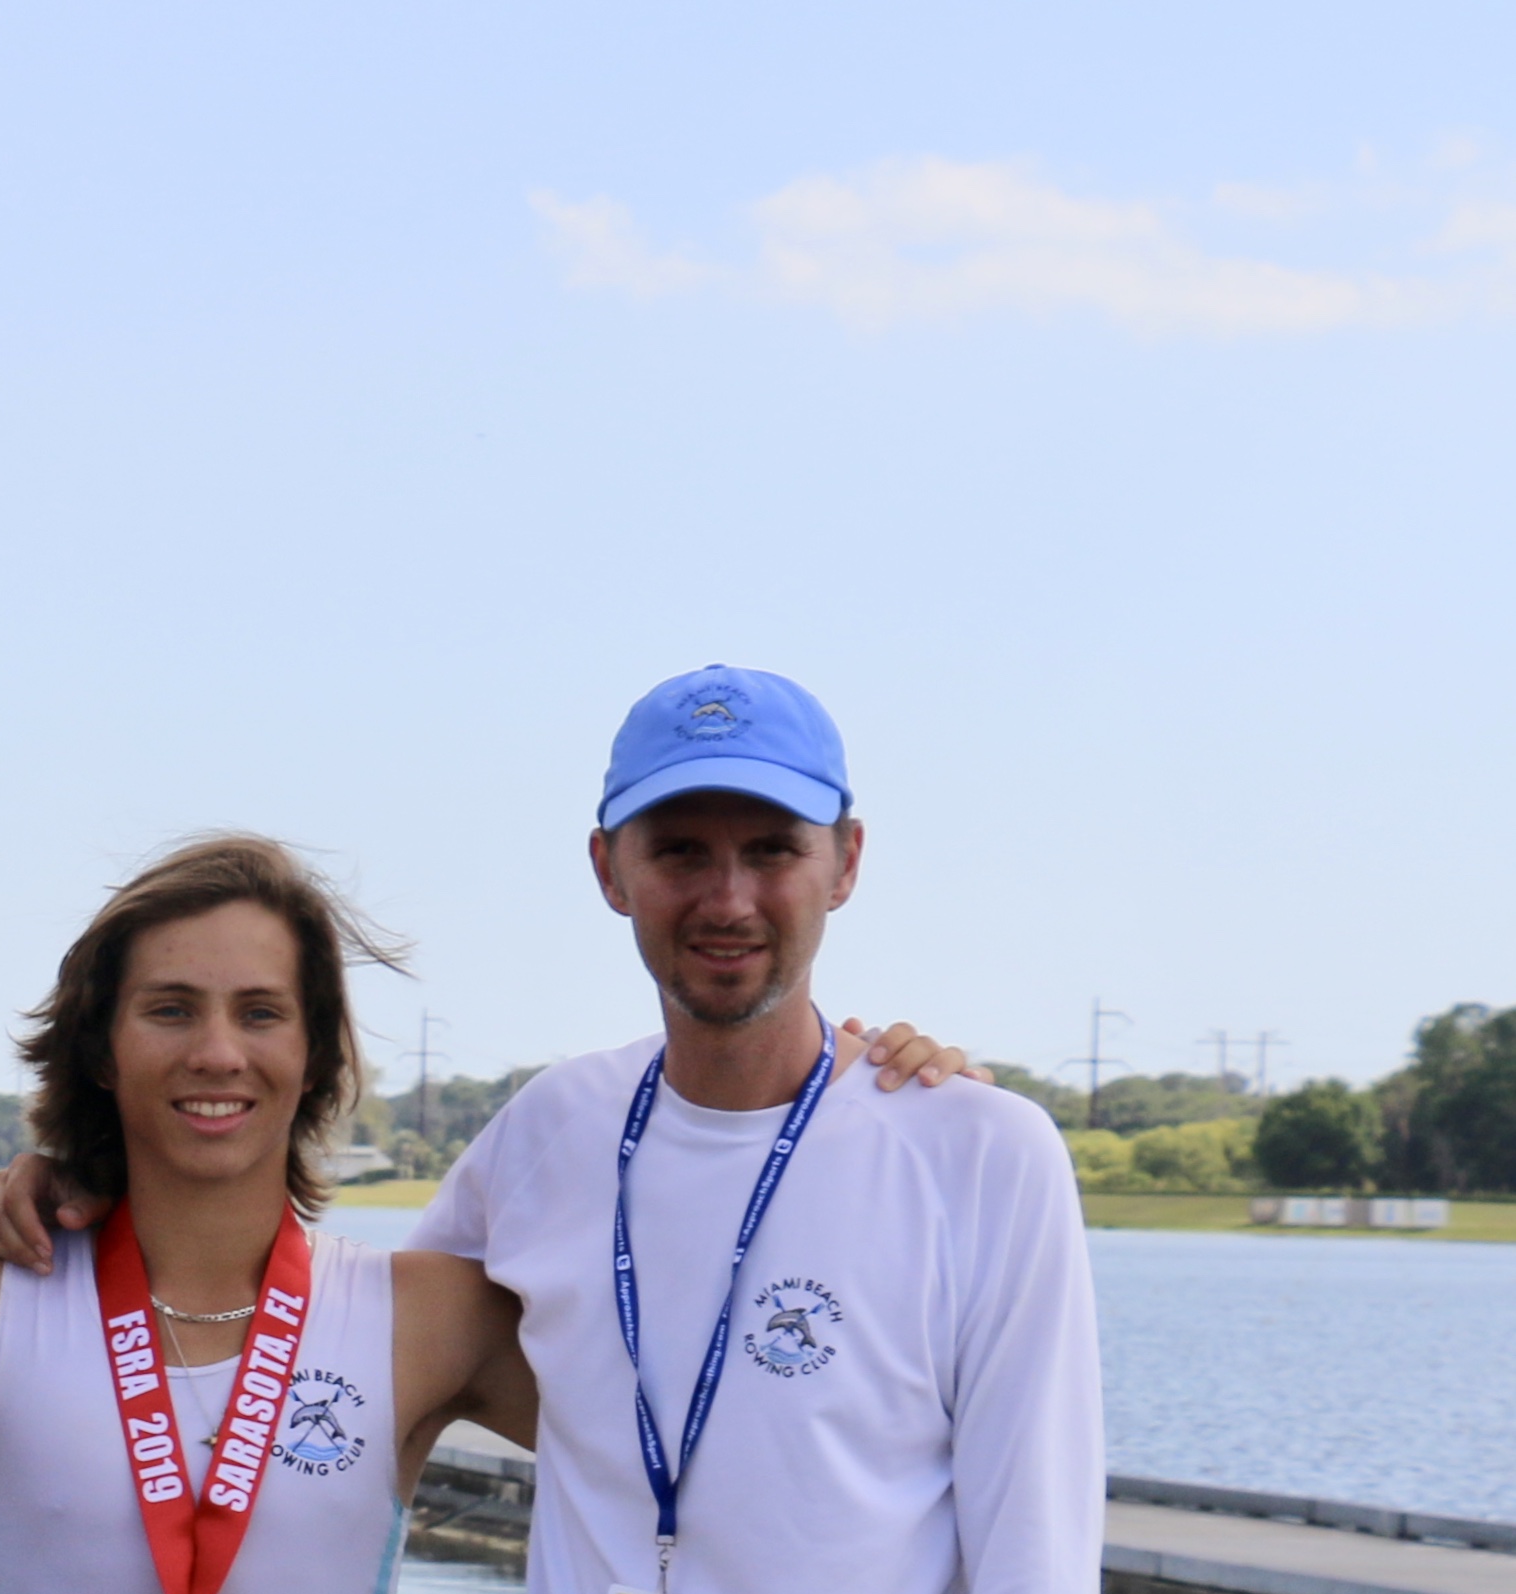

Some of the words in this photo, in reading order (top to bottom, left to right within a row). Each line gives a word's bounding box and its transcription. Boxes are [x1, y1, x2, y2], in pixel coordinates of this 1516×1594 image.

[754, 1278, 801, 1308] MIAMI
[804, 1279, 843, 1322] BEACH
[108, 1309, 160, 1401] FSRA
[744, 1333, 794, 1378] ROWING
[801, 1345, 836, 1375] CLUB
[208, 1333, 299, 1513] SARASOTA,
[264, 1287, 304, 1327] FL
[315, 1369, 365, 1407] BEACH
[128, 1412, 183, 1504] 2019
[271, 1438, 329, 1476] OWING
[336, 1437, 365, 1472] CLUB
